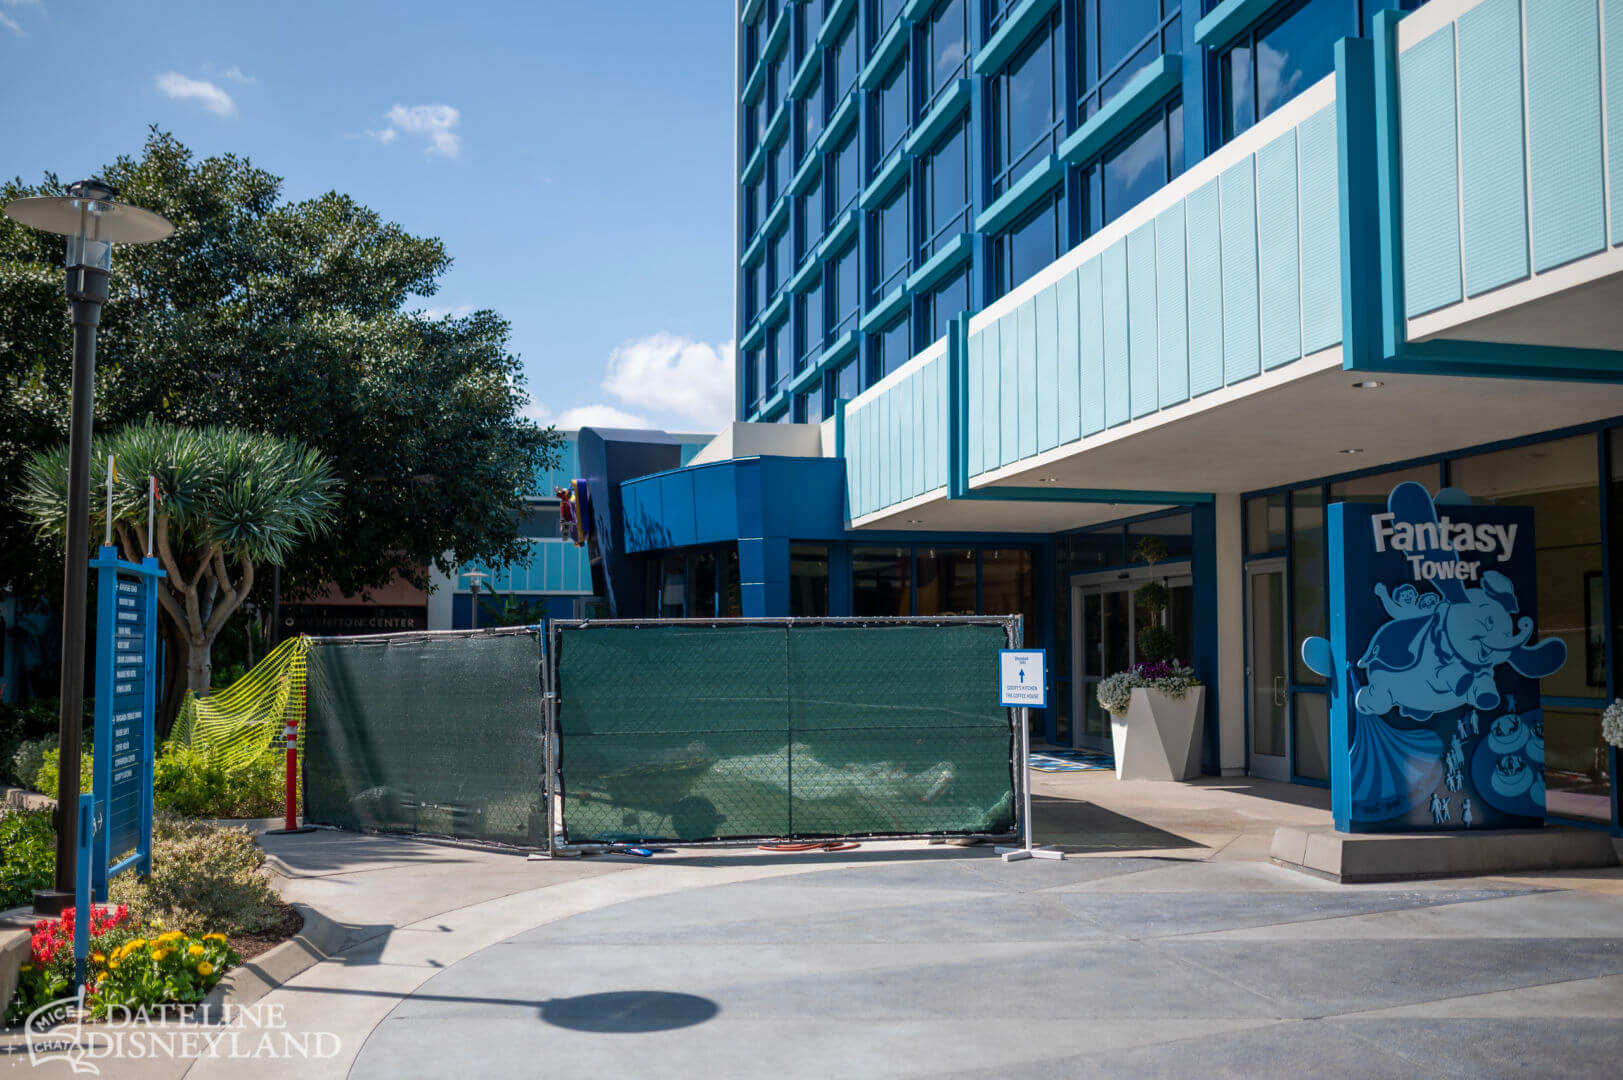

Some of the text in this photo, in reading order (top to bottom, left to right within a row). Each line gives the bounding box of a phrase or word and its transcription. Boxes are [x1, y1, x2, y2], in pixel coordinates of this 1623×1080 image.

[1372, 512, 1518, 562] Fantasy
[1407, 555, 1480, 581] Tower
[369, 617, 415, 627] CENTER
